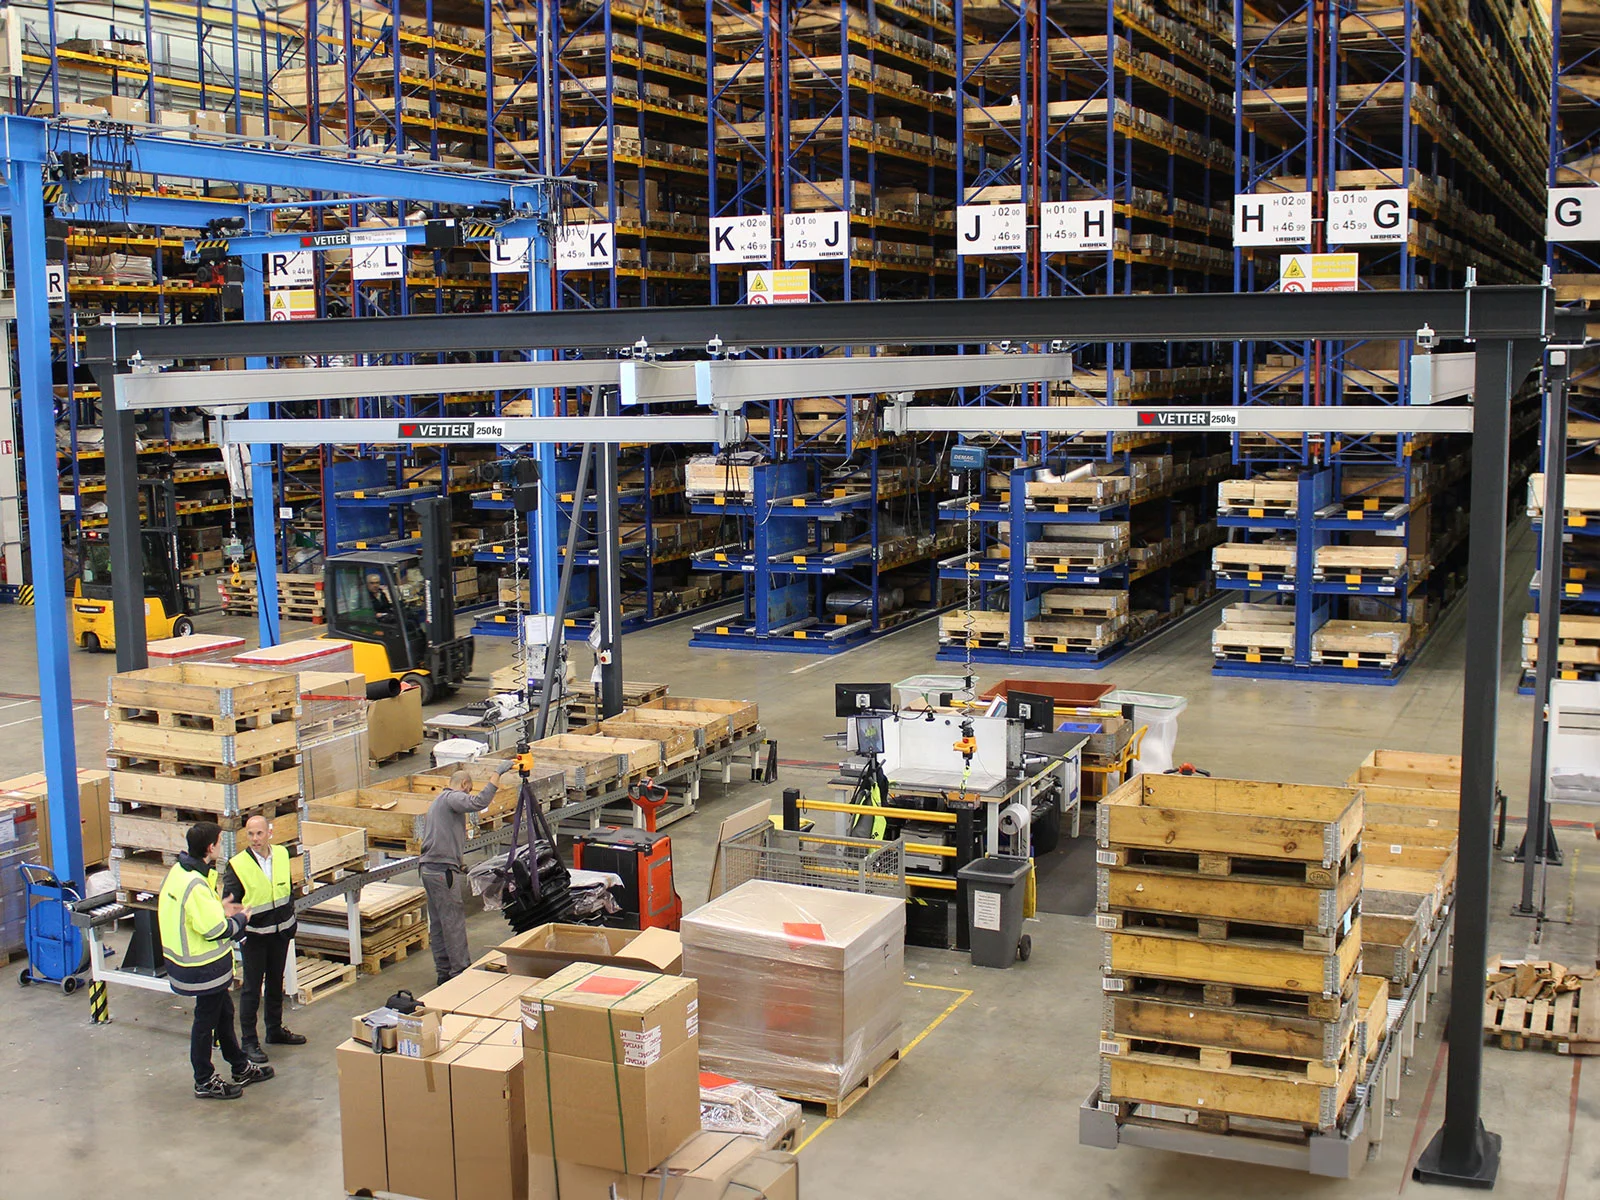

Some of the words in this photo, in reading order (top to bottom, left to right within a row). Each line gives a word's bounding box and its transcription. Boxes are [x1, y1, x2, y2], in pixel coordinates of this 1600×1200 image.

[1281, 196, 1294, 206] 02
[1342, 194, 1355, 204] 01
[998, 207, 1009, 216] 02
[1054, 205, 1065, 214] 01
[1373, 199, 1400, 229] G
[1555, 197, 1582, 227] G
[747, 219, 758, 227] 02
[795, 217, 806, 225] 01
[1241, 204, 1264, 232] H
[964, 215, 981, 241] J
[1084, 210, 1104, 238] H
[1281, 222, 1294, 231] 46
[1342, 220, 1356, 230] 45
[1357, 222, 1367, 230] 99
[314, 234, 348, 245] VETTER
[715, 226, 735, 251] K
[824, 221, 839, 247] J
[998, 232, 1009, 241] 46
[1054, 230, 1067, 239] 45
[590, 232, 608, 257] K
[747, 242, 758, 250] 46
[796, 240, 808, 248] 45
[385, 246, 397, 267] L
[567, 250, 577, 258] 45
[274, 255, 288, 276] R
[49, 273, 61, 293] R
[1158, 413, 1206, 424] VETTER
[1211, 415, 1236, 425] 250kg
[419, 424, 469, 436] VETTER
[476, 426, 502, 436] 250kg
